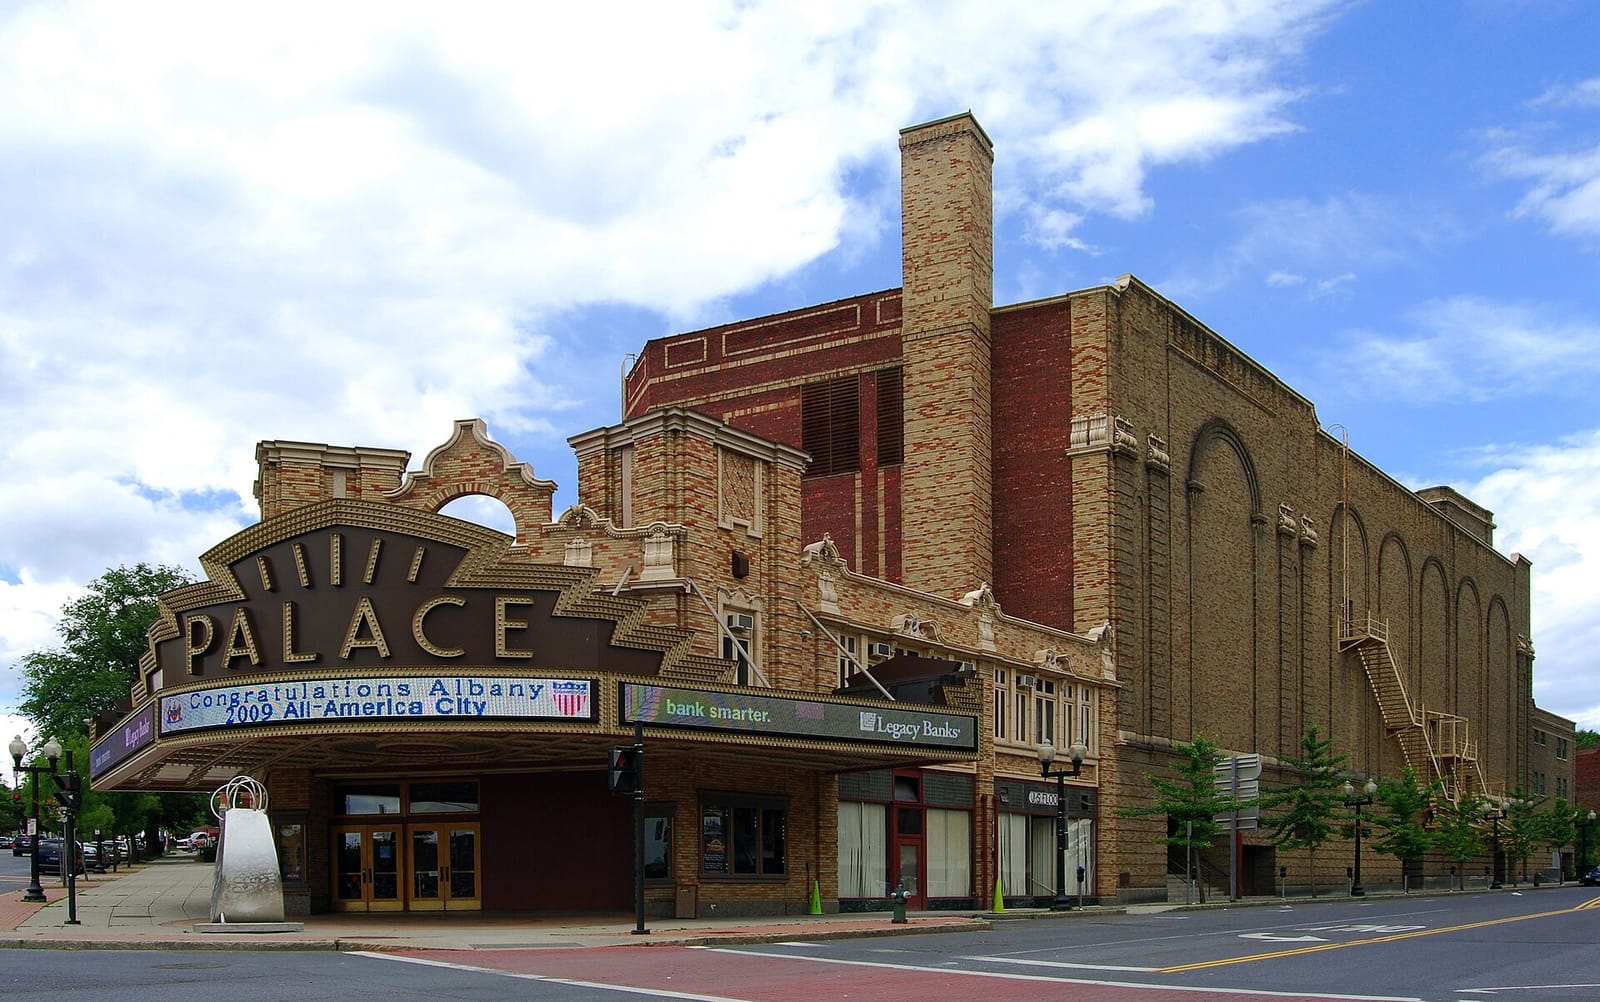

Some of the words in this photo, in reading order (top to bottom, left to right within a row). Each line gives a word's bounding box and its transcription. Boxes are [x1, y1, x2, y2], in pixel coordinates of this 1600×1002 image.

[185, 595, 535, 675] PALACE
[190, 680, 411, 709] Congratulations
[429, 679, 544, 700] Albany
[225, 703, 274, 725] 2009
[283, 698, 424, 719] All-America
[435, 697, 487, 717] City
[666, 699, 705, 718] bank
[709, 705, 771, 723] smarter.
[877, 716, 920, 740] Legacy
[923, 720, 958, 739] Banks
